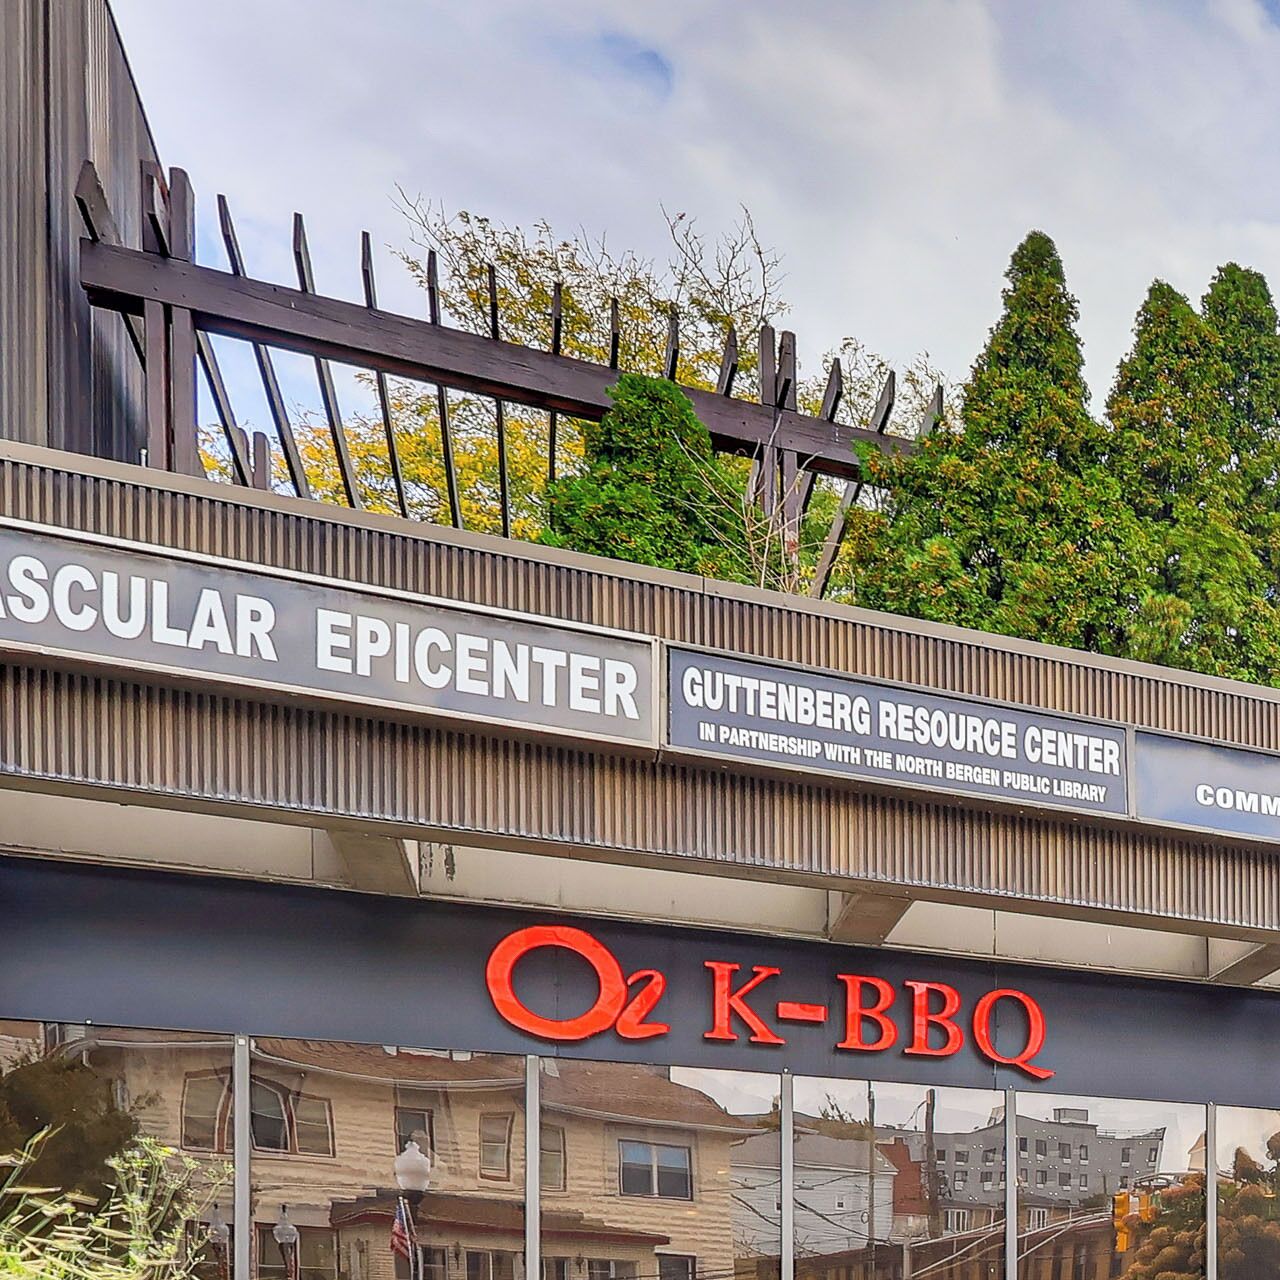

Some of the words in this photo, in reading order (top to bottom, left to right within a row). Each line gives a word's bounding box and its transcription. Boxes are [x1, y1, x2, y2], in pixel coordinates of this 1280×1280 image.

[0, 555, 279, 662] SCULAR
[316, 607, 640, 720] EPICENTER
[682, 666, 871, 736] GUTTENBERG
[879, 701, 1017, 759] RESOURCE
[1024, 725, 1120, 776] CENTER
[699, 721, 715, 740] IN
[719, 724, 821, 757] PARTNERSHIP
[824, 741, 861, 765] WITH
[864, 746, 892, 770] THE
[896, 753, 943, 778] NORTH
[946, 762, 1000, 787] BERGEN
[1003, 771, 1050, 795] PUBLIC
[1053, 779, 1107, 803] LIBRARY
[703, 961, 1056, 1079] K-BBQ
